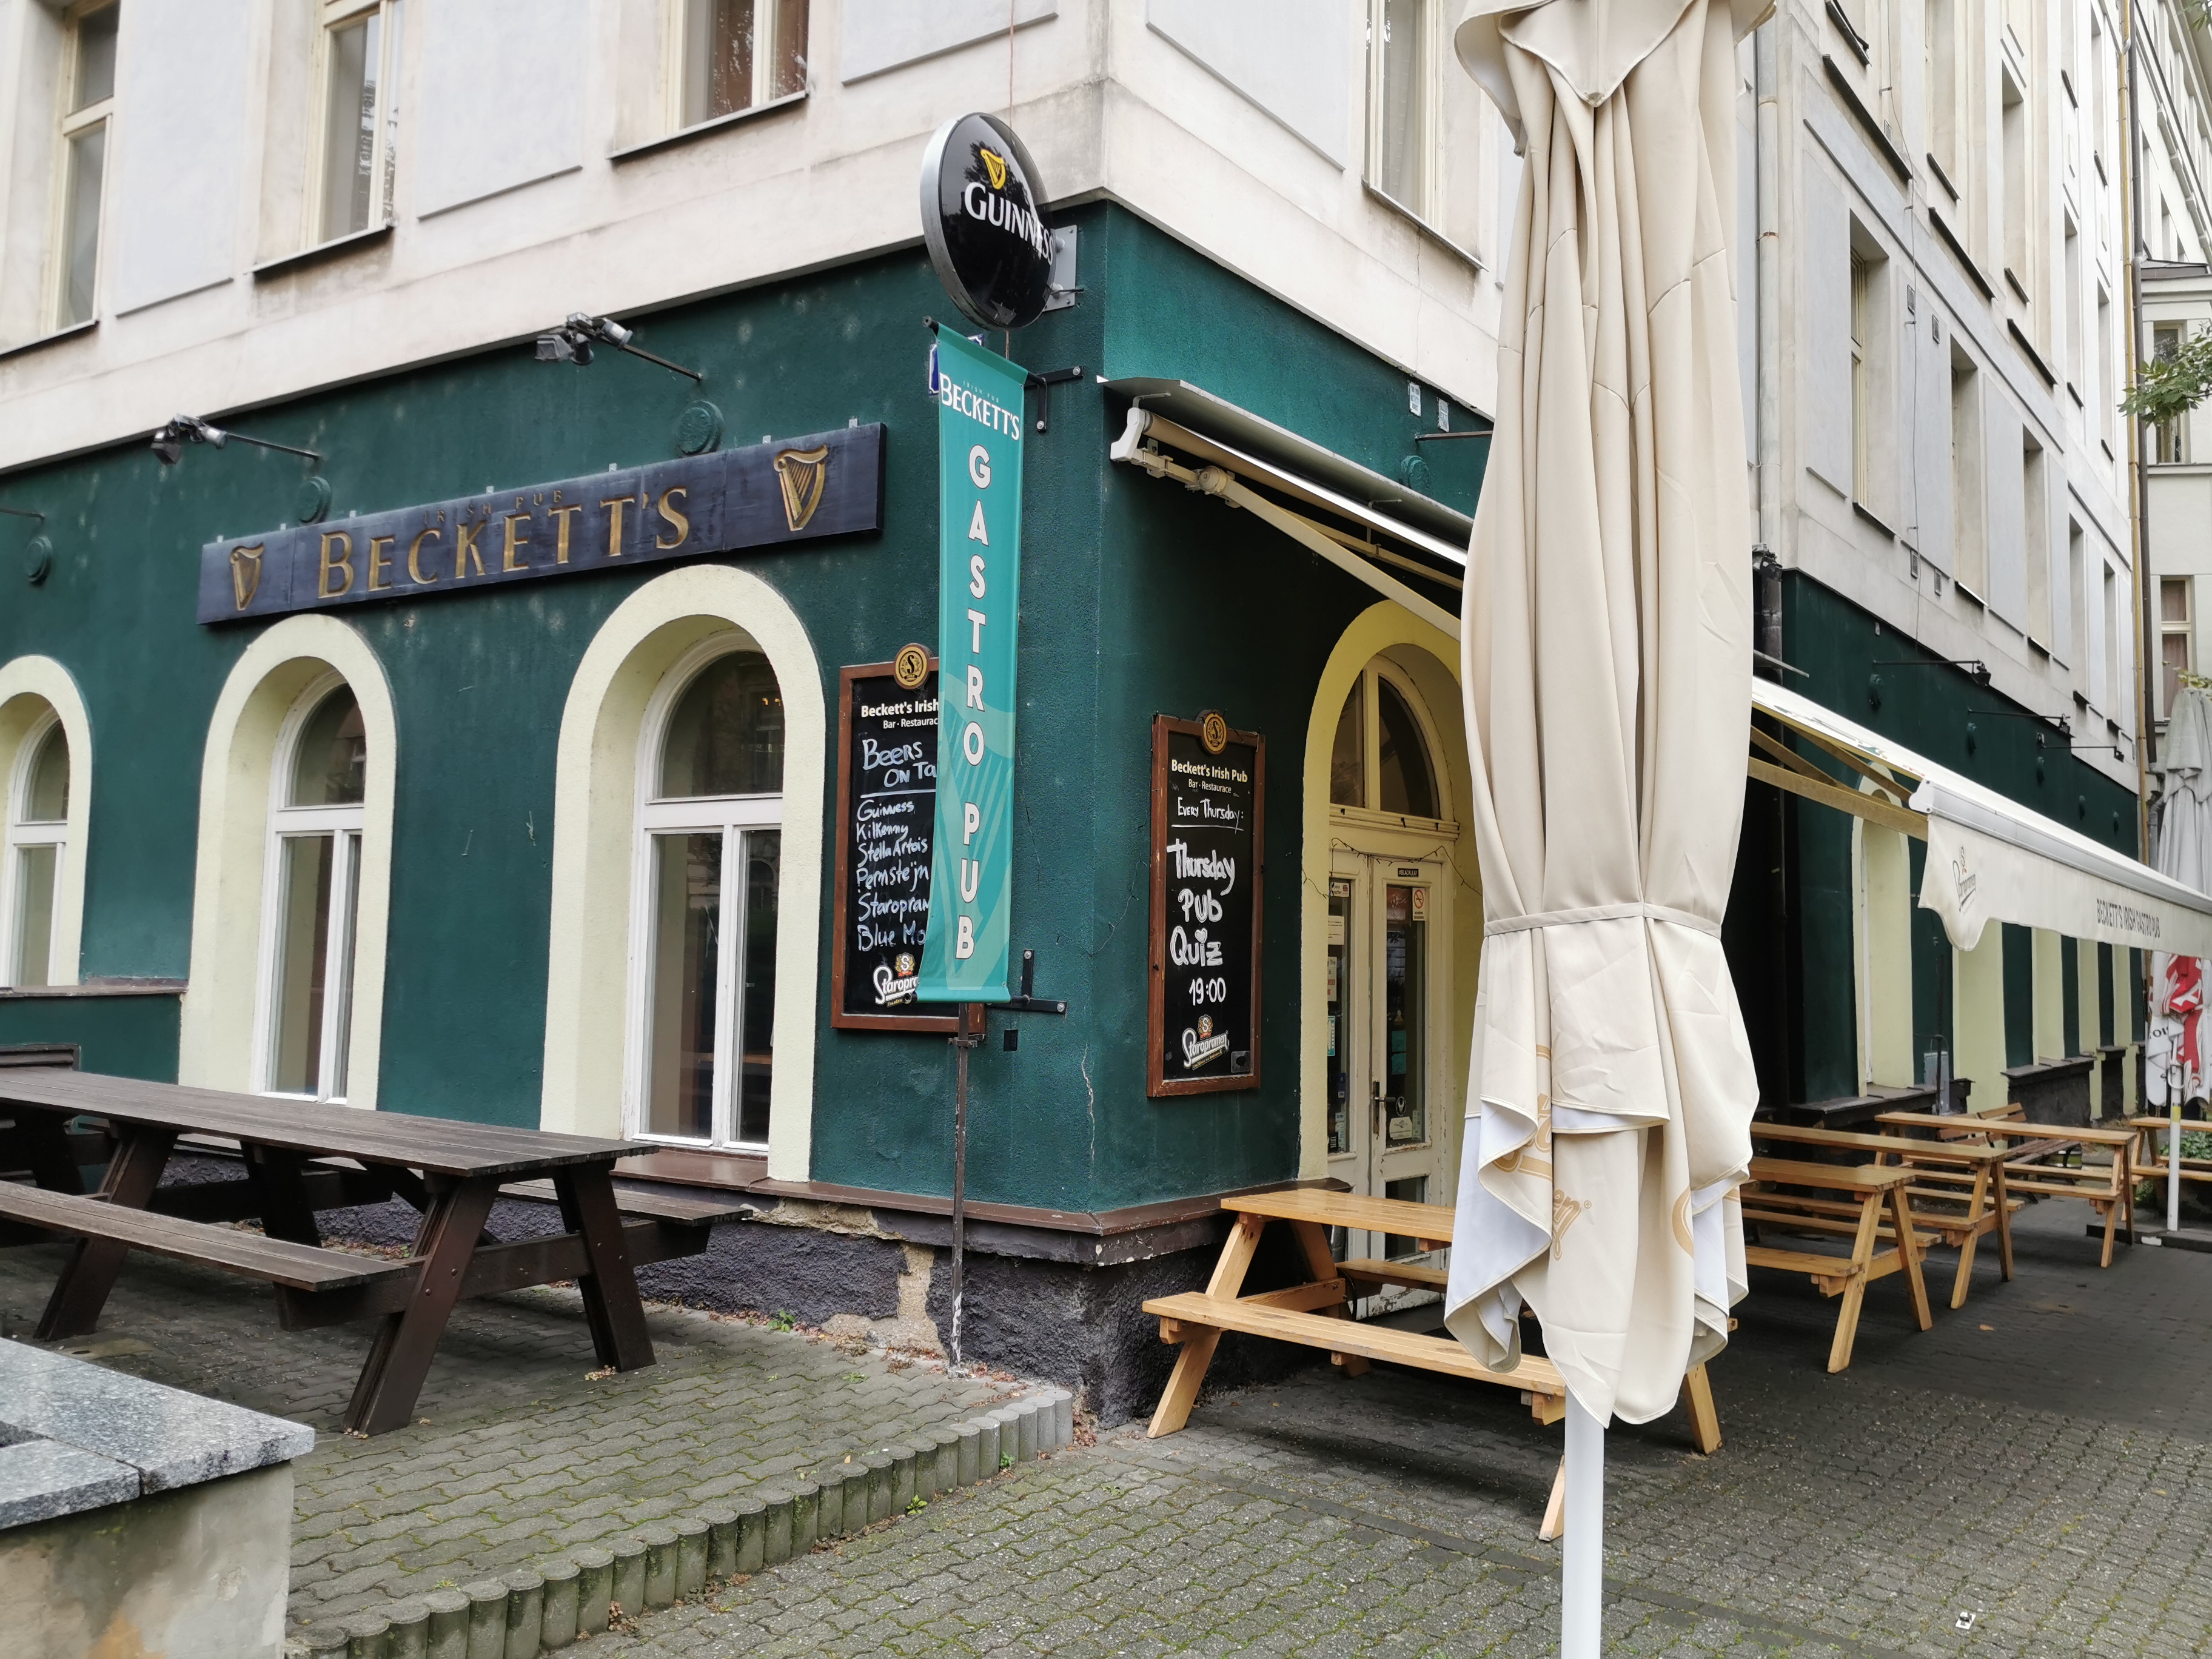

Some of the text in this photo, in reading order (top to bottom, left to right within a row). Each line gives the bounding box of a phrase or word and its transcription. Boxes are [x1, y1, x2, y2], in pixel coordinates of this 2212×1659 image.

[965, 182, 1054, 266] GUINNESS
[939, 372, 1020, 441] BECKETT'S
[963, 381, 999, 403] IRISH PUB
[424, 490, 563, 525] IRISH PUB
[318, 487, 690, 599] BECKETT'S
[963, 444, 991, 766] GASTRO
[860, 702, 913, 717] Beckett's
[883, 717, 939, 729] Bar Restaurac
[913, 762, 937, 780] Ta
[1171, 759, 1248, 783] Beckett's Irish Pub
[1188, 779, 1232, 794] Bar Restaurace
[955, 802, 980, 960] PUB
[1166, 838, 1235, 896] Thursday
[857, 920, 926, 952] Blue Mo
[1189, 977, 1226, 1006] 19:00
[1182, 1030, 1229, 1068] Staropramen
